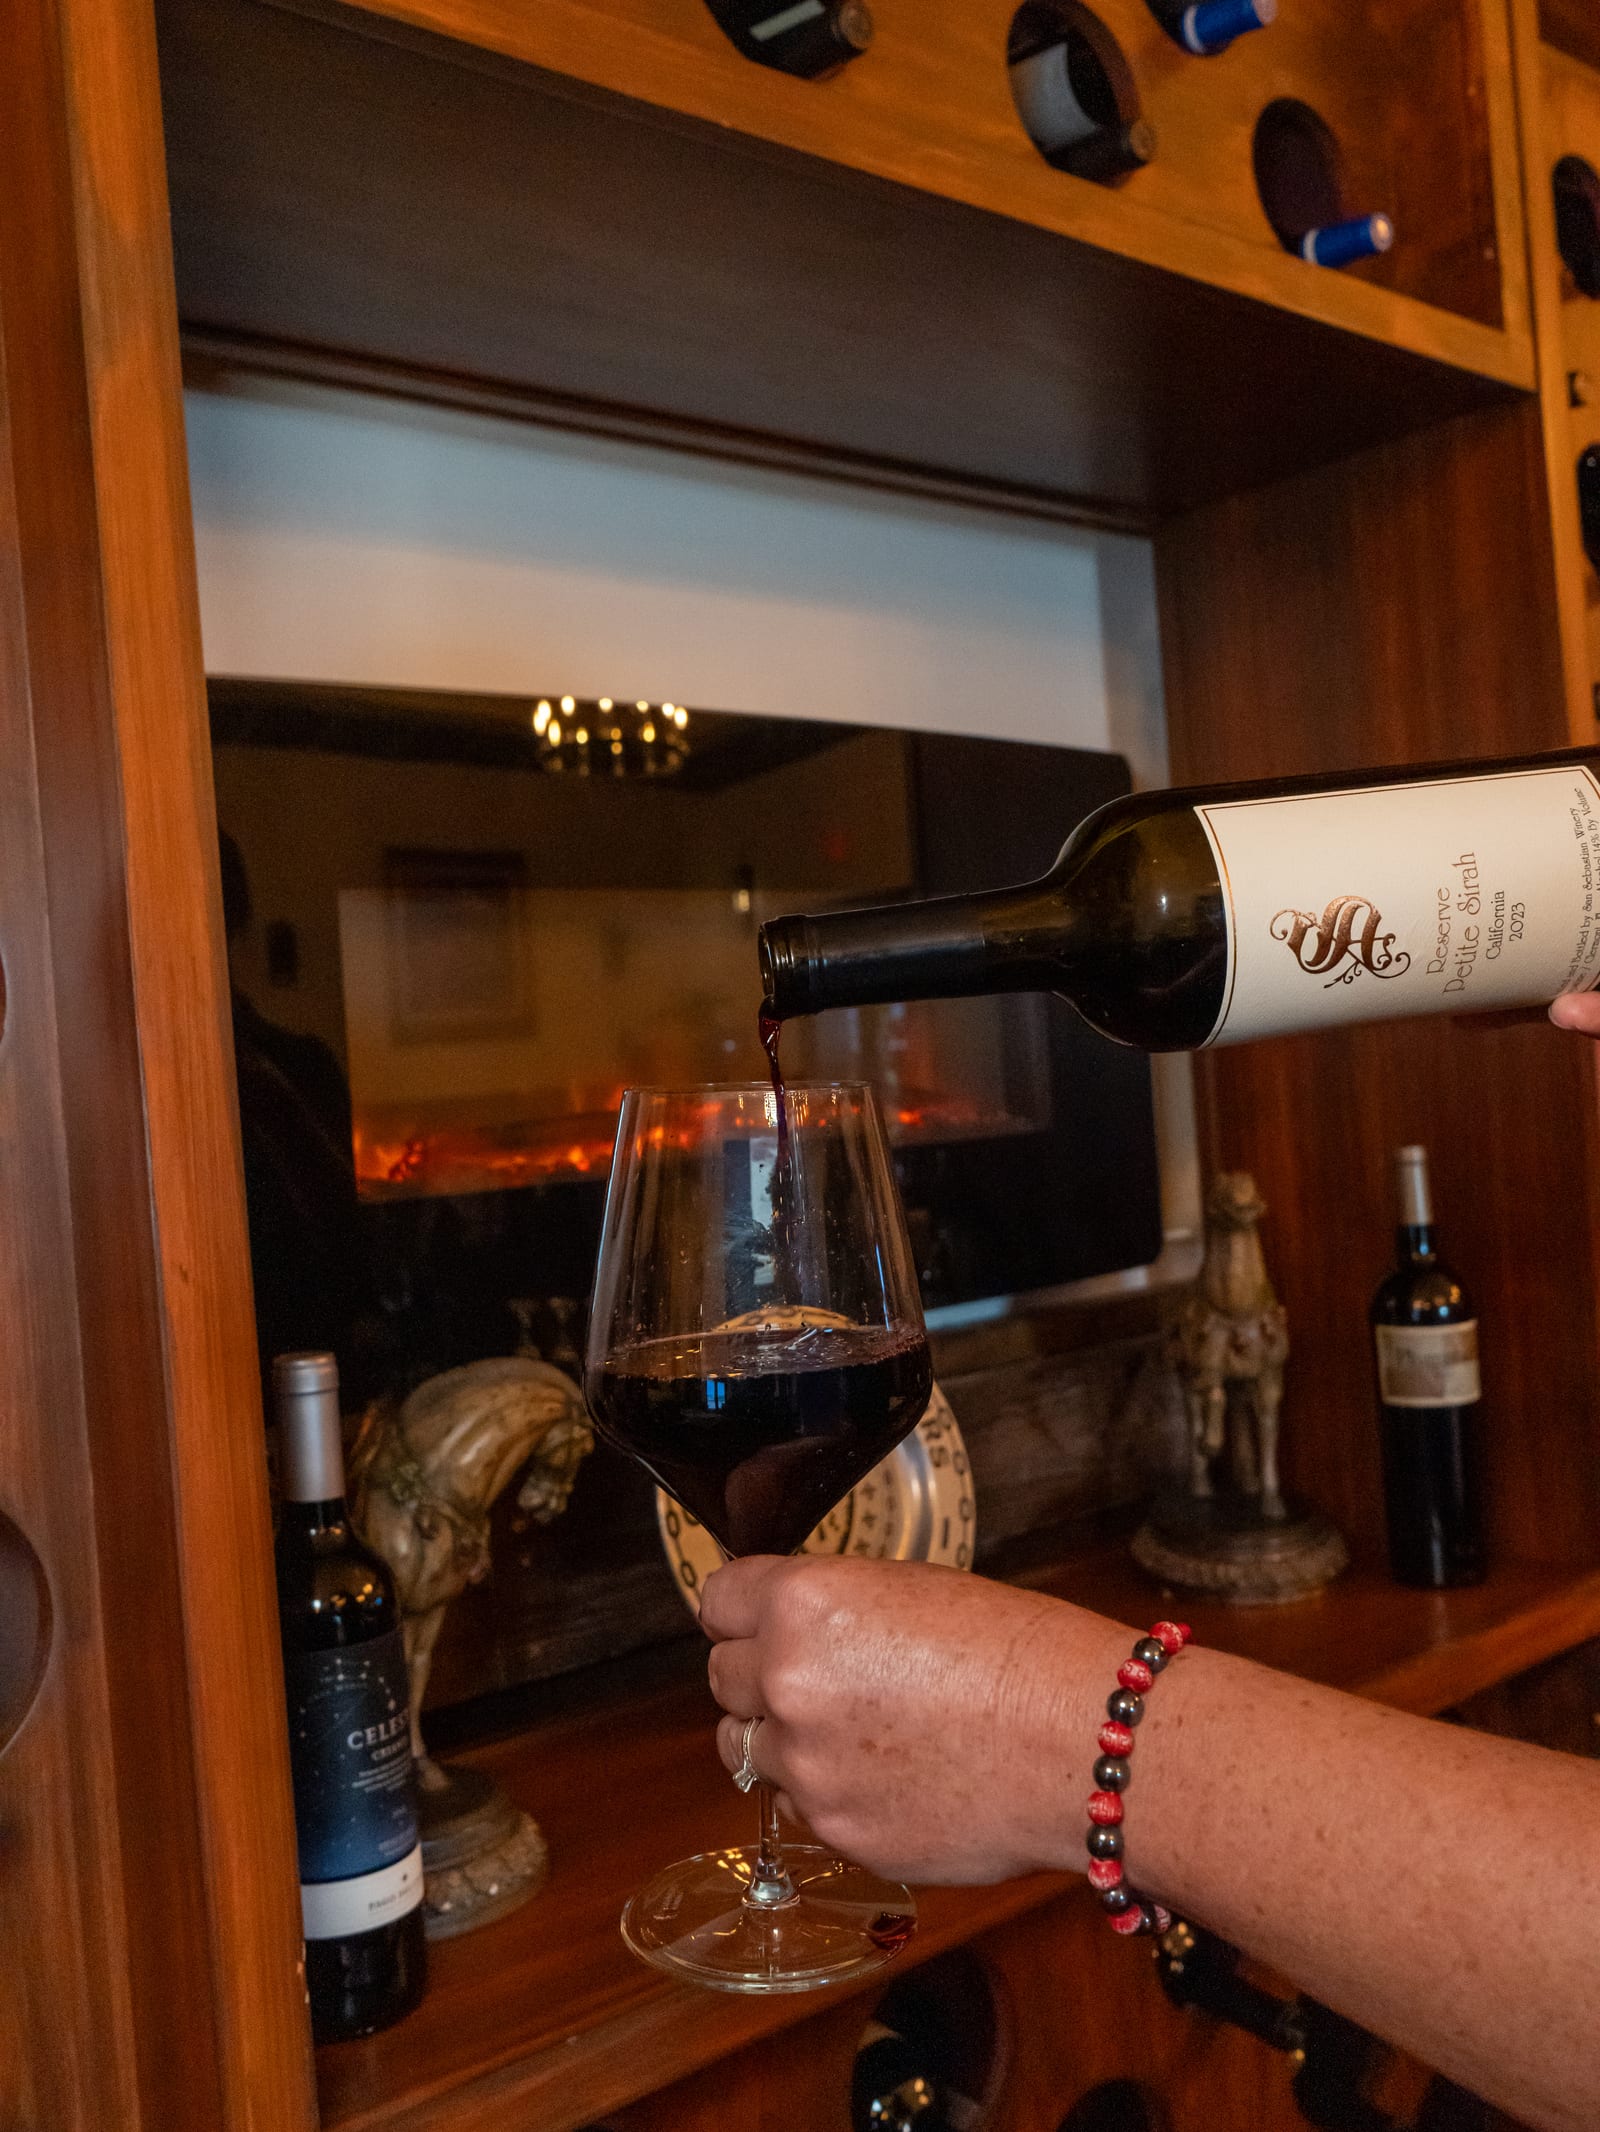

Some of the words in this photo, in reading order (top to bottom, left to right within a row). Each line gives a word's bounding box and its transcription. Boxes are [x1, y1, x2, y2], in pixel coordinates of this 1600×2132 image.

[1569, 807, 1585, 840] Winery
[1573, 787, 1592, 816] Volume
[1452, 852, 1481, 915] Sirah
[1580, 841, 1593, 891] Sebastian
[1509, 902, 1525, 941] 2023
[1580, 915, 1594, 928] by
[1582, 893, 1593, 912] San
[1426, 887, 1451, 974] Reserve
[1486, 890, 1505, 960] California
[1442, 925, 1480, 993] Petite
